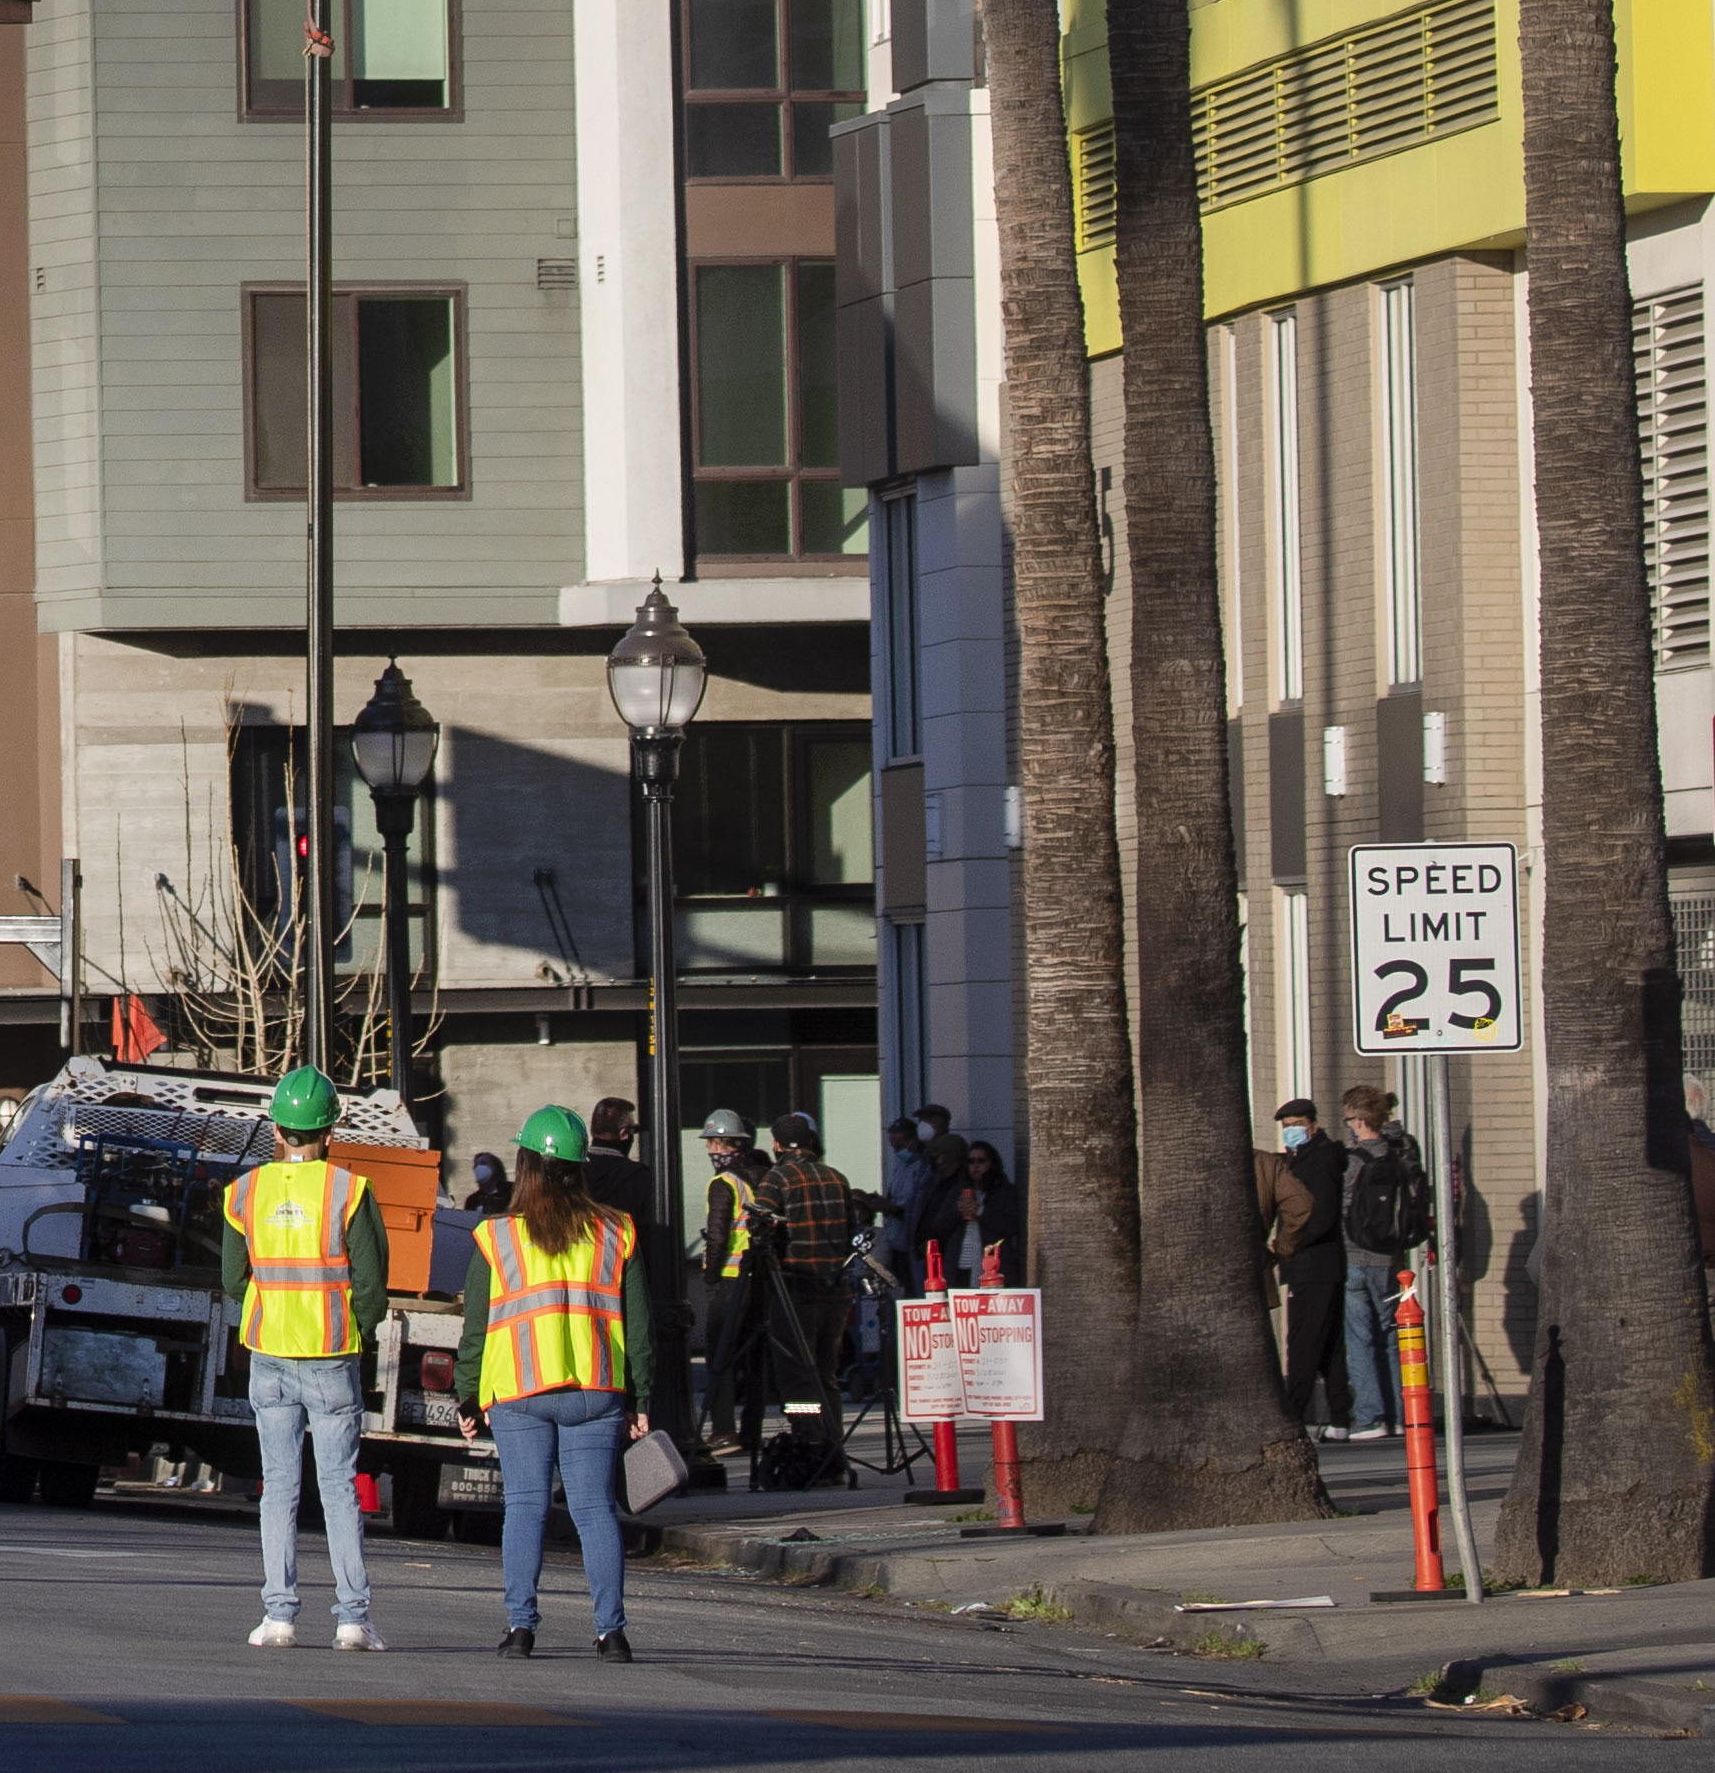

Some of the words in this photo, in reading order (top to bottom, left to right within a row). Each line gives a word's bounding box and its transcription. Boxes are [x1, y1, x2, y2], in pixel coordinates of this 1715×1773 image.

[1368, 864, 1502, 895] SPEED
[1384, 912, 1487, 942] LIMIT
[1374, 958, 1502, 1031] 25
[905, 1325, 930, 1359] NO
[956, 1317, 979, 1353] NO
[980, 1327, 1033, 1343] STOPPING
[463, 1467, 490, 1482] TRUCK
